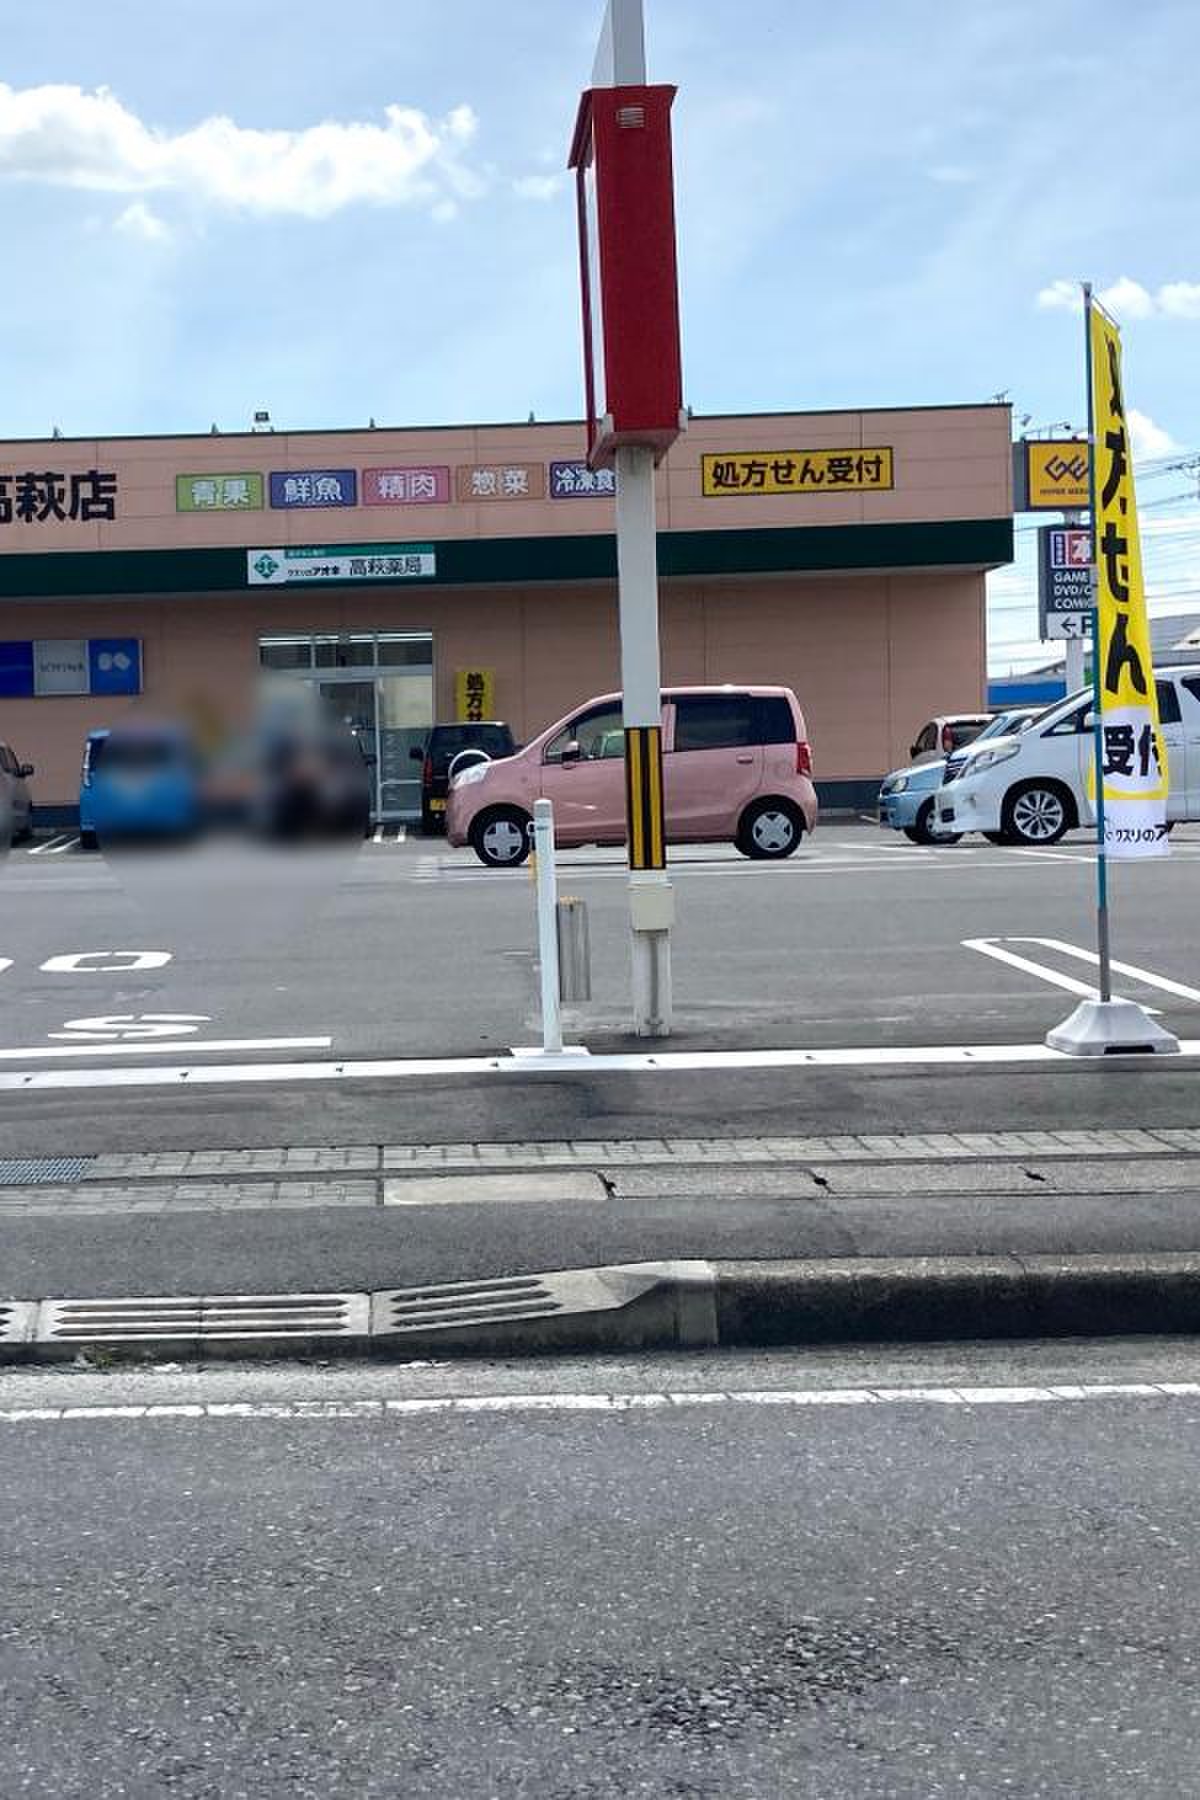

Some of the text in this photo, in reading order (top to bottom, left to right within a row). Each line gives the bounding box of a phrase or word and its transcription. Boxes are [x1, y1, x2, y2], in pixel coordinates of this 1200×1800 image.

[471, 469, 530, 496] 惣菜
[555, 468, 615, 493] 冷凍食
[711, 455, 884, 488] 処方せん受付
[191, 479, 250, 506] 青果
[283, 477, 343, 503] 鮮魚
[377, 473, 436, 499] 精肉
[1101, 333, 1147, 695] 方せん
[1054, 571, 1089, 583] GAME
[1054, 584, 1092, 595] DVD/C
[1103, 724, 1163, 777] 受付
[1116, 824, 1168, 843] クスリのア
